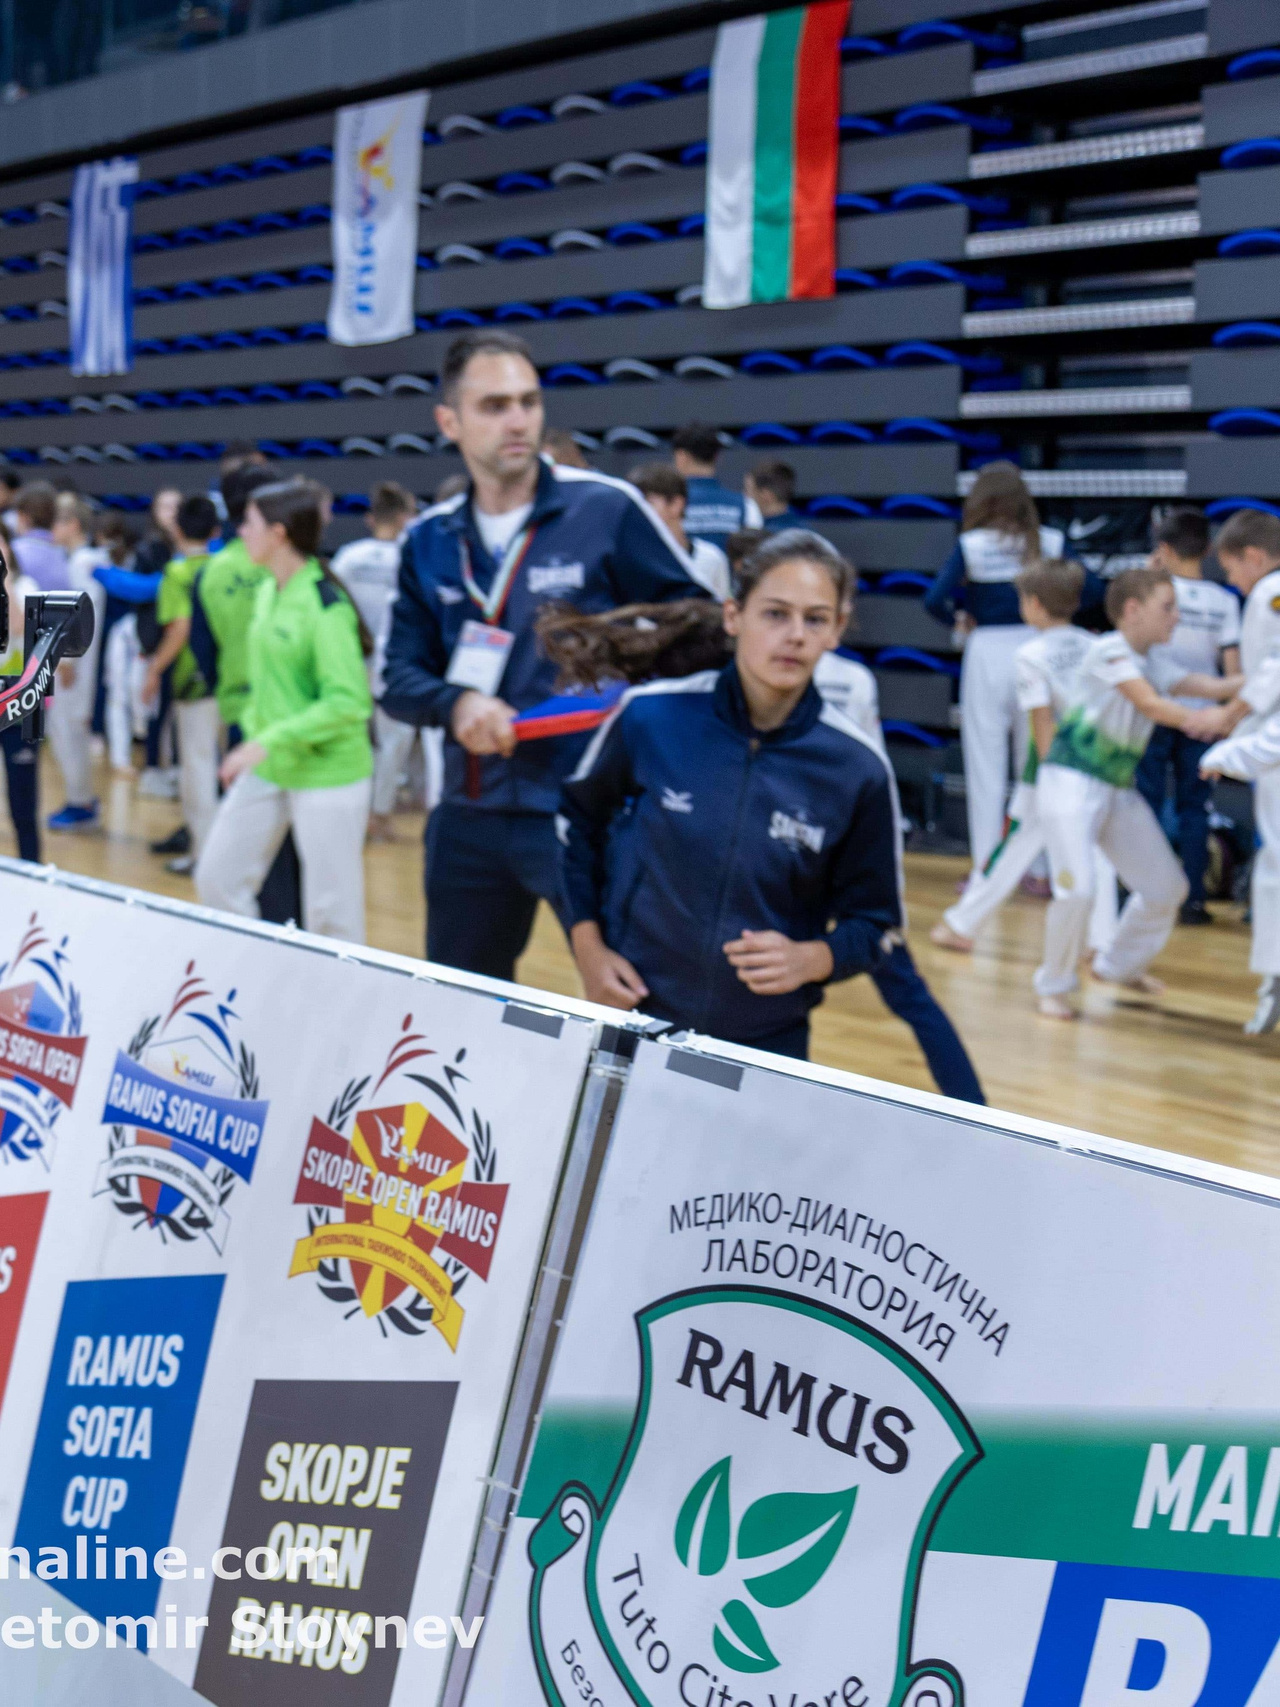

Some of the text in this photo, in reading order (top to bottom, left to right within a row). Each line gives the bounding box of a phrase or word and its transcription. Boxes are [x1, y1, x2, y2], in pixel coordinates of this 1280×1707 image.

[6, 659, 51, 721] RONIN
[6, 1033, 46, 1073] SOFIA
[44, 1046, 81, 1086] OPEN
[108, 1073, 261, 1158] RAMUS SOFIA CUP
[303, 1147, 497, 1248] SKOPJE OPEN RAMUS
[669, 1192, 1011, 1357] МЕДИКО-ДИАГНОСТИЧНА
[702, 1239, 957, 1362] ЛАБОРАТОРИЯ
[66, 1334, 185, 1388] RAMUS
[63, 1405, 153, 1460] SOFIA
[676, 1327, 916, 1475] RAMUS
[62, 1475, 129, 1530] CUP
[260, 1441, 413, 1510] SKOPJE
[1132, 1443, 1280, 1538] MAI
[263, 1521, 373, 1590] OPEN
[228, 1597, 373, 1675] RAMUS
[613, 1553, 670, 1673] Tuto
[679, 1663, 754, 1707] Cit
